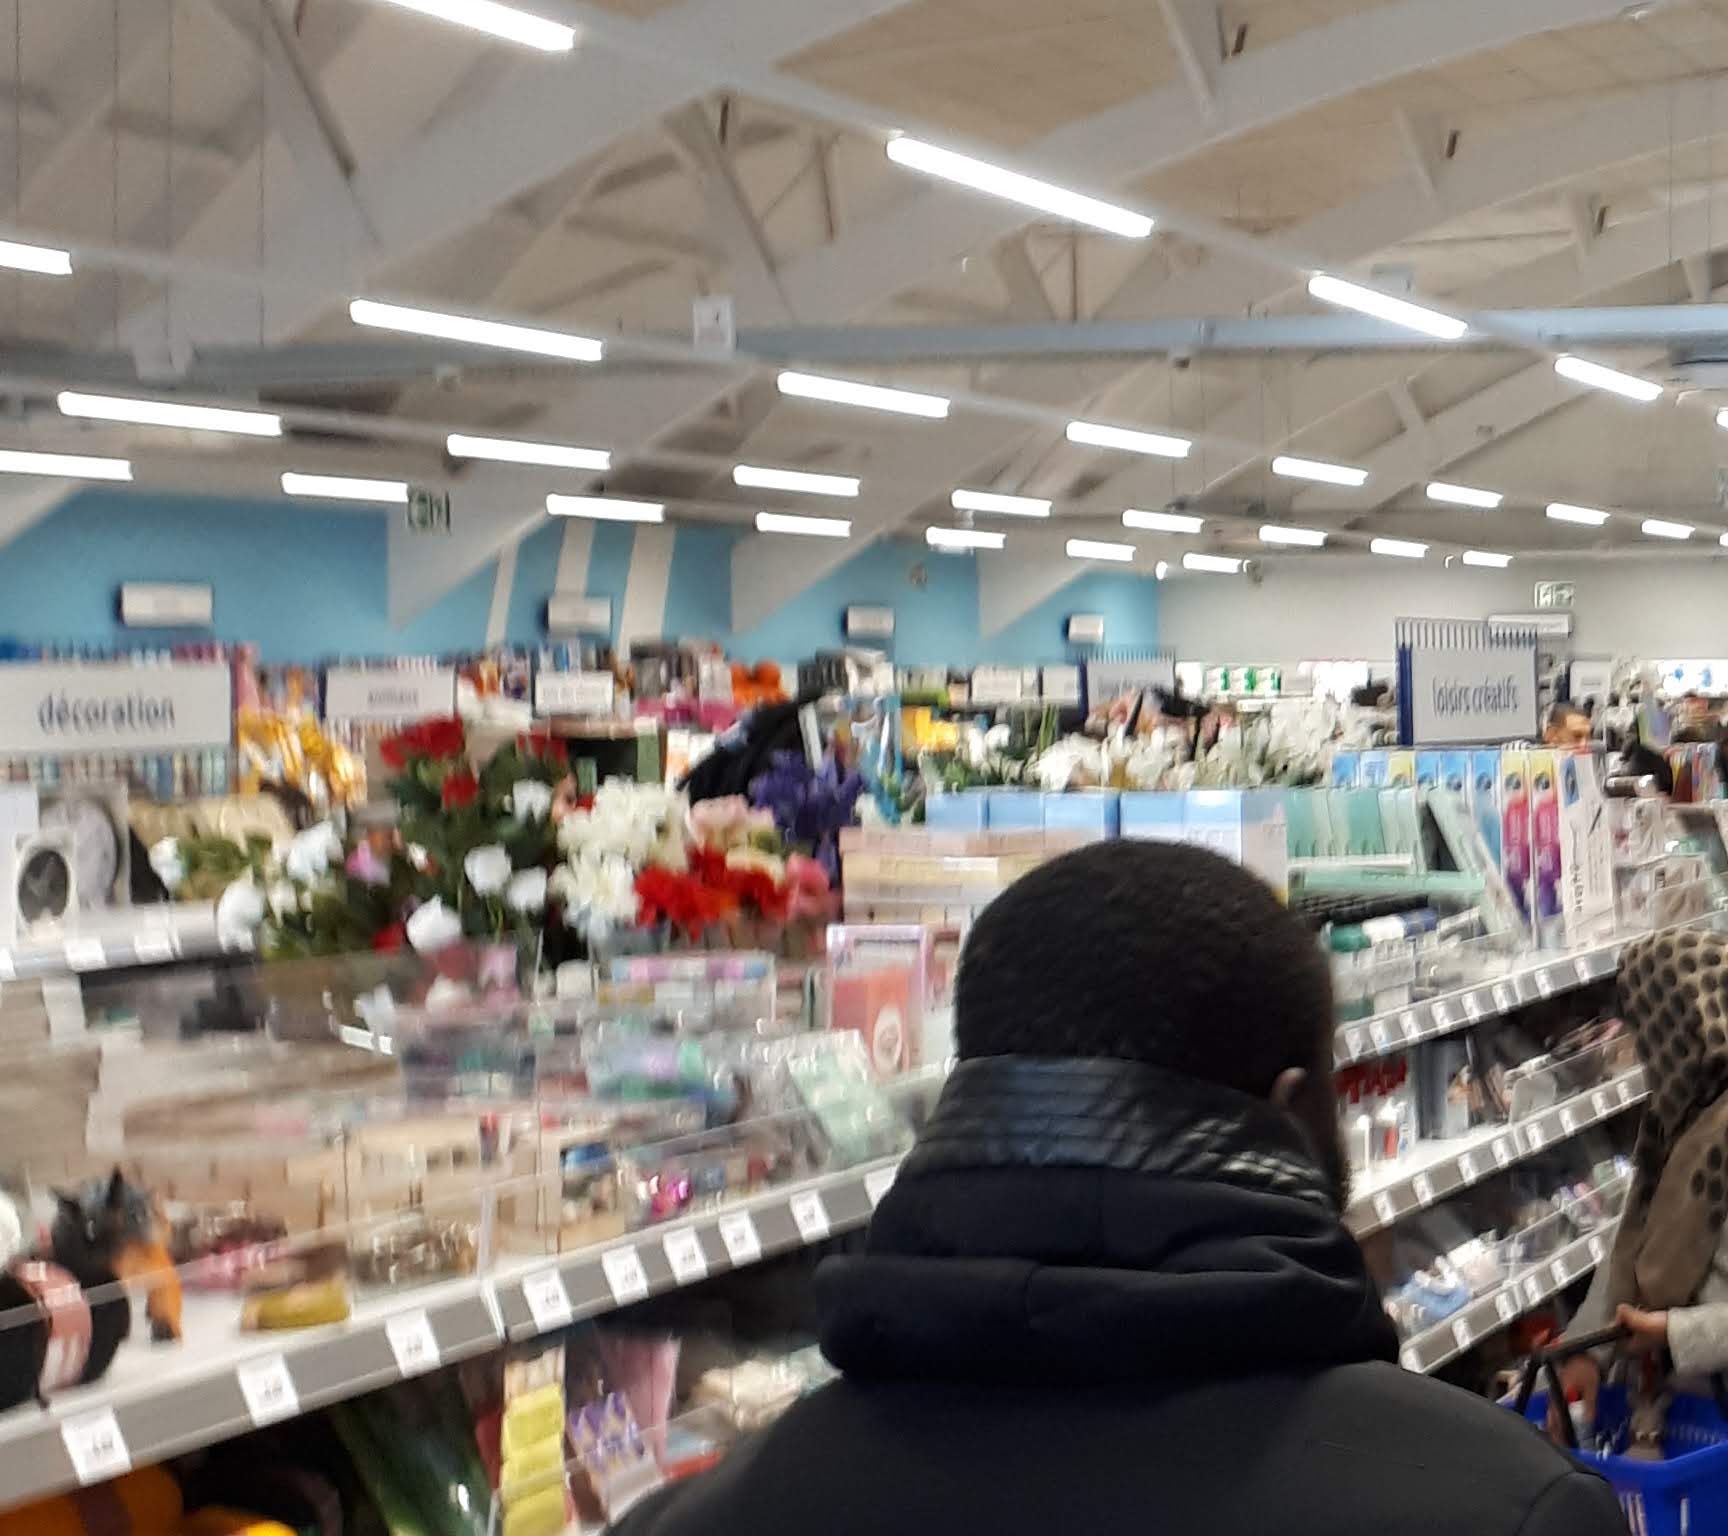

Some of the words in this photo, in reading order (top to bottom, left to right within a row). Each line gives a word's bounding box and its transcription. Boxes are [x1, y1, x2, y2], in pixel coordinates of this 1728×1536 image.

[37, 687, 176, 735] décoration
[1432, 675, 1470, 716] loisirs
[1472, 674, 1519, 713] créatifs
